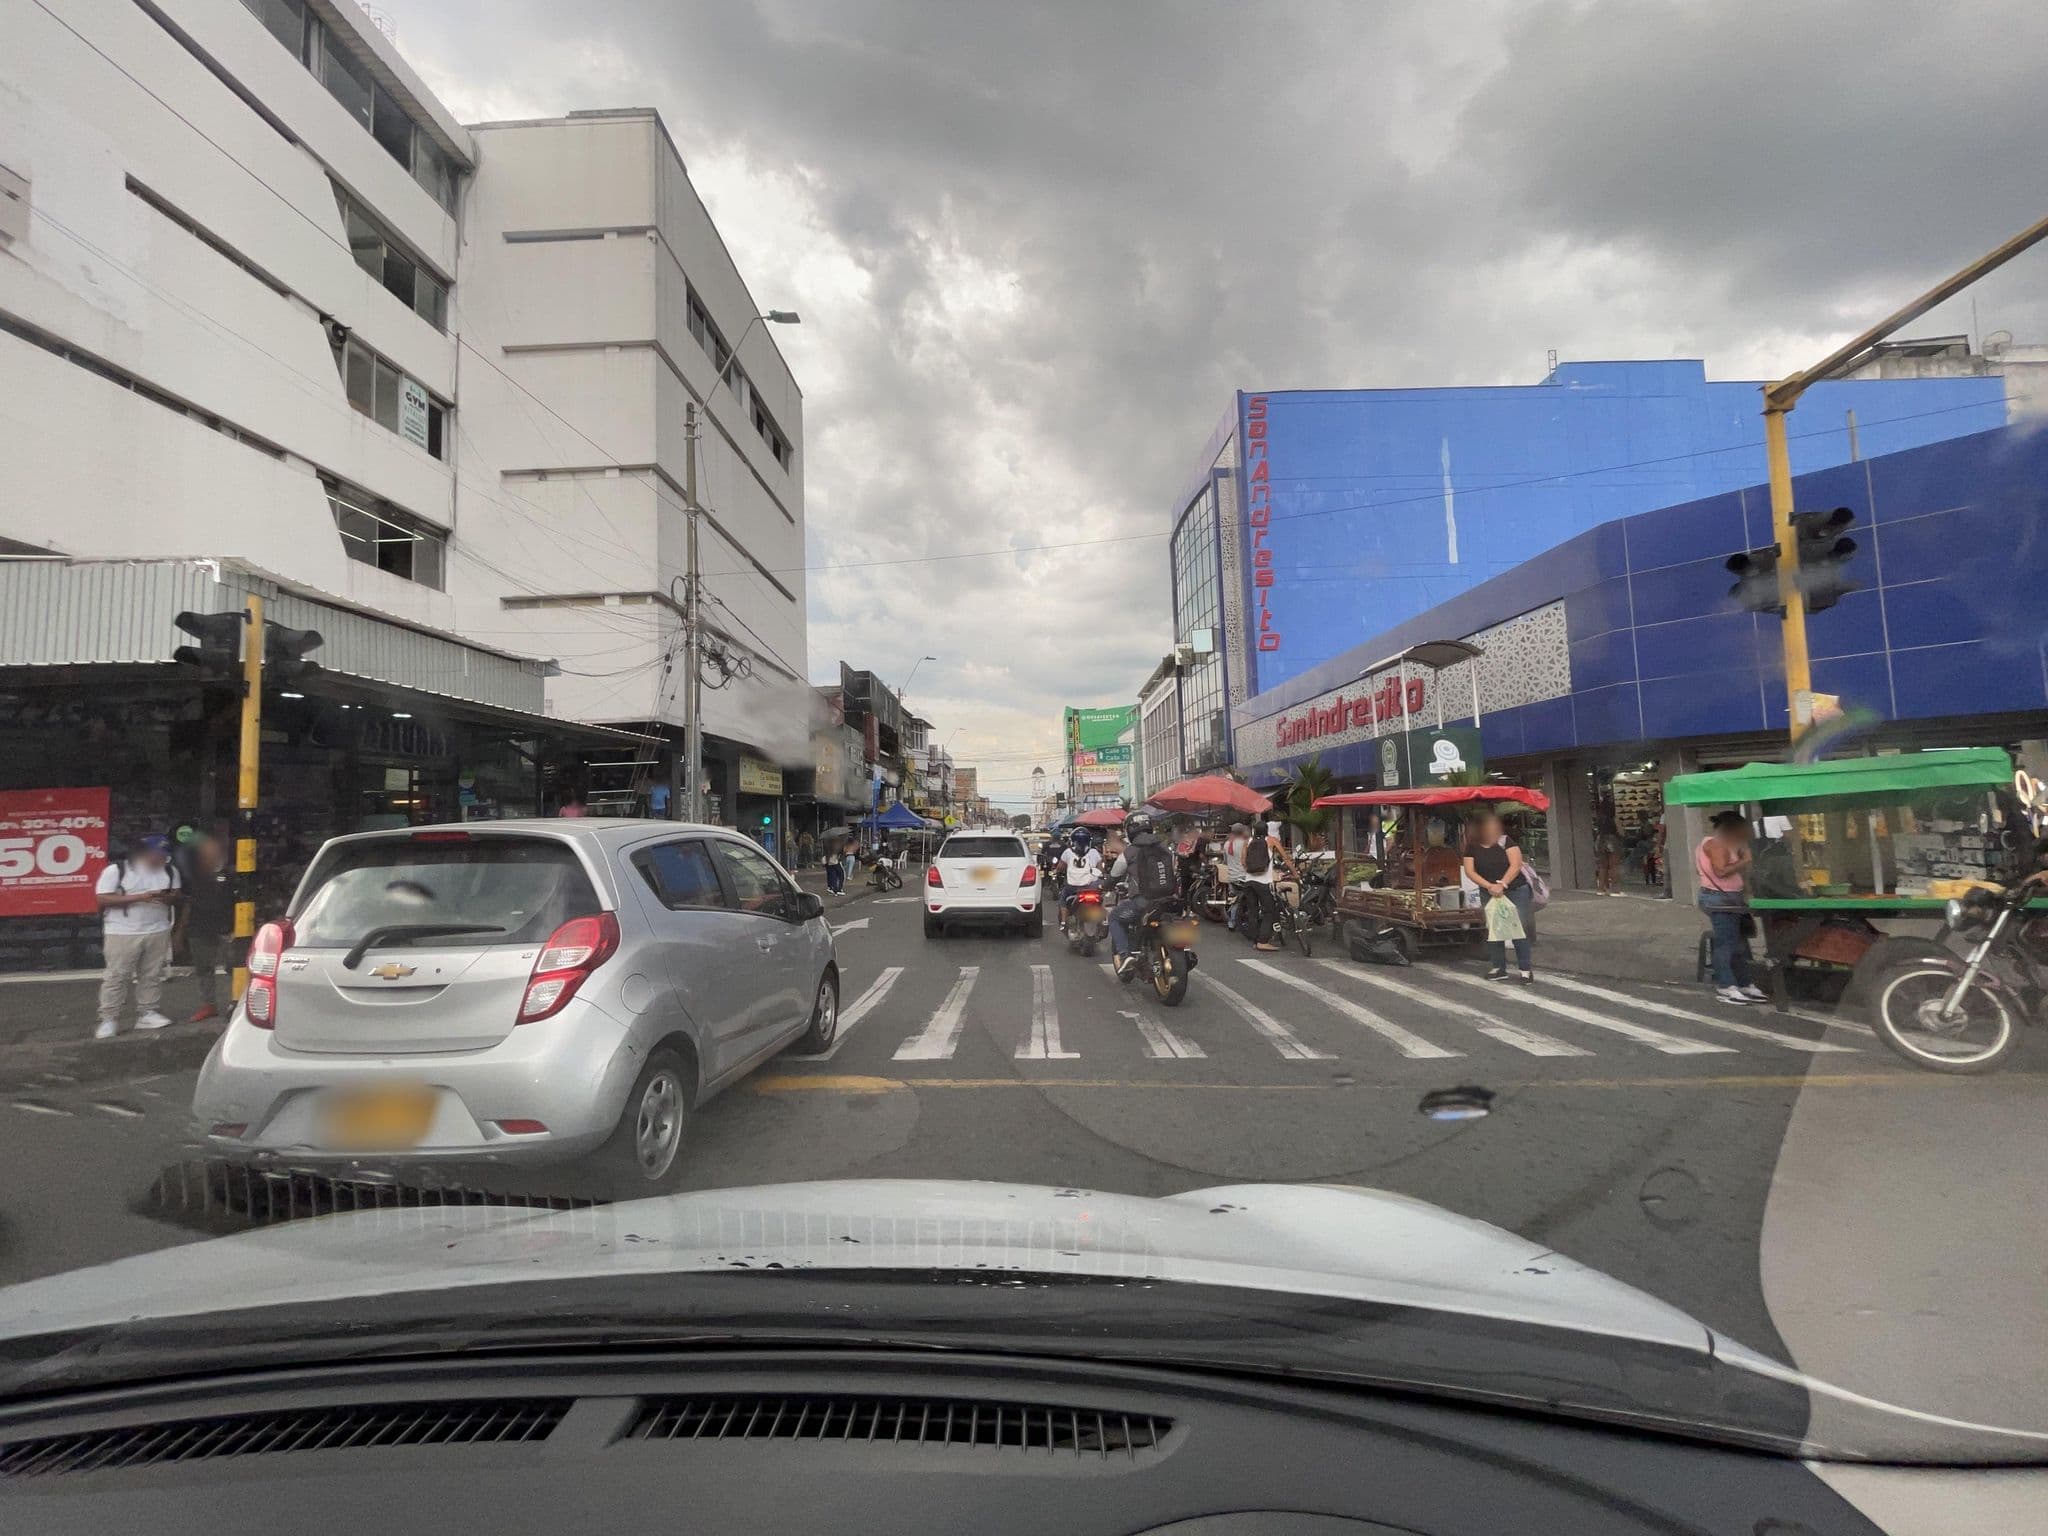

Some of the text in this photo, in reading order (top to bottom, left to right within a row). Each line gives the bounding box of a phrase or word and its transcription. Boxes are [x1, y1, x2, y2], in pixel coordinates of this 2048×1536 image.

[405, 391, 425, 411] GYM
[1276, 676, 1425, 748] SanAndresito
[59, 816, 105, 829] 40%
[0, 834, 105, 877] 50%
